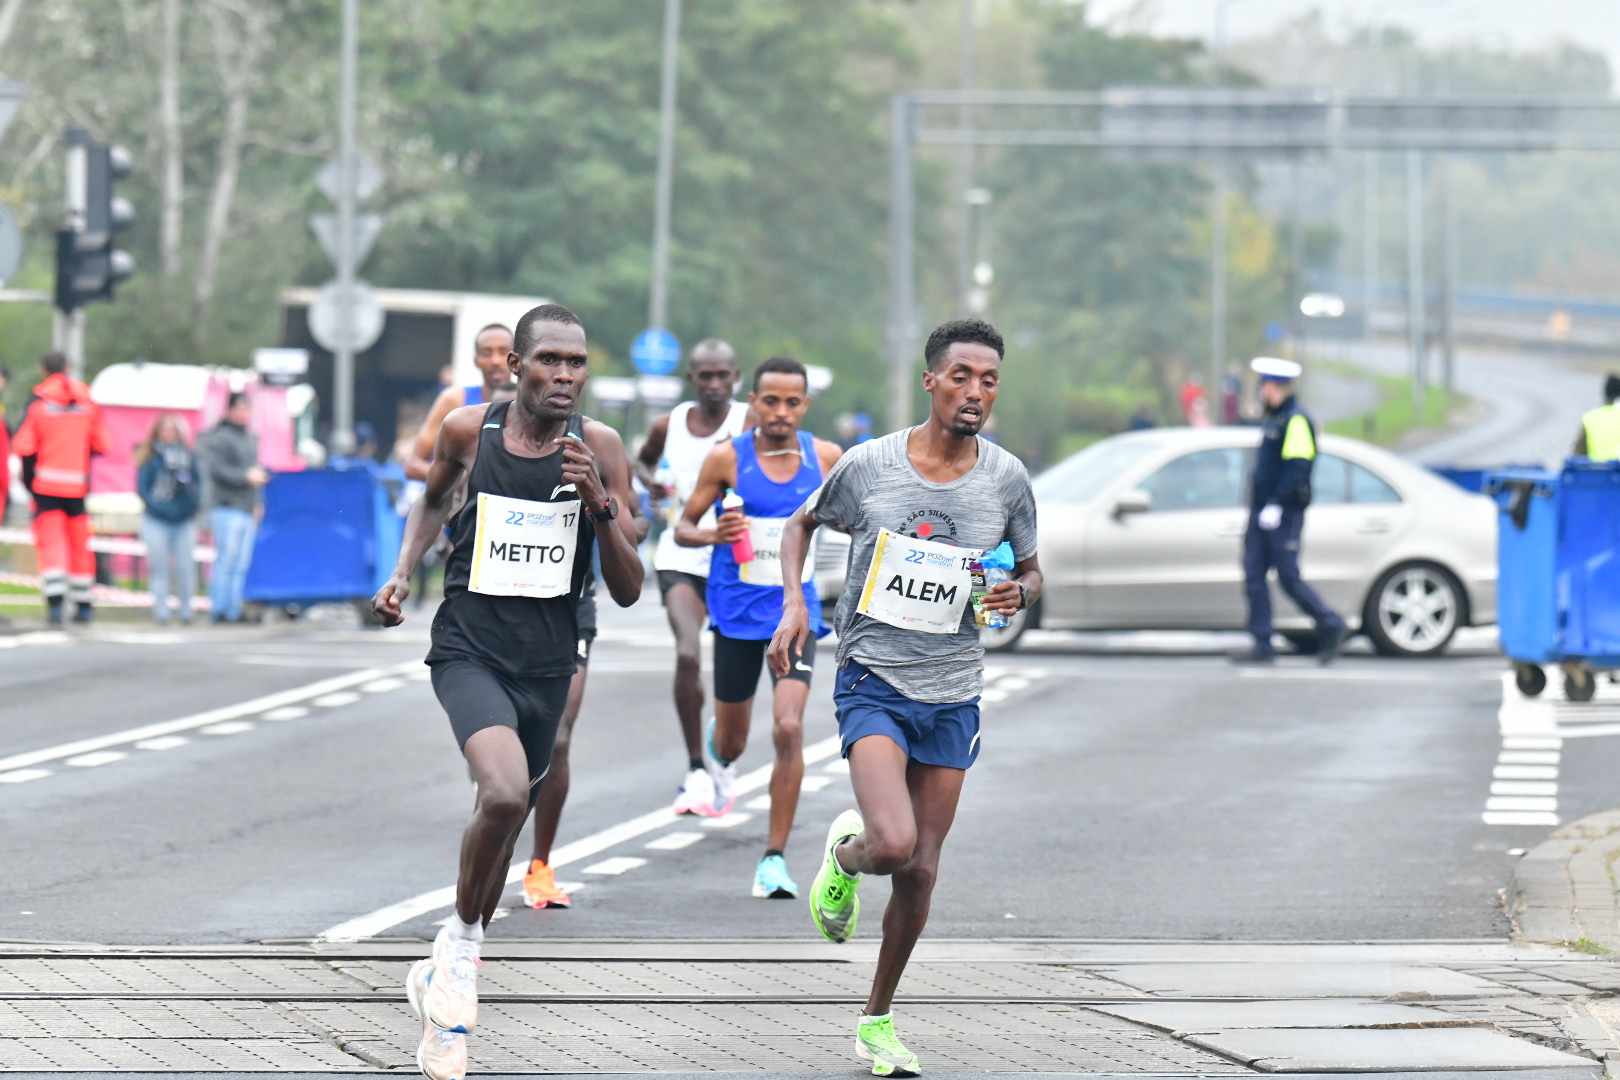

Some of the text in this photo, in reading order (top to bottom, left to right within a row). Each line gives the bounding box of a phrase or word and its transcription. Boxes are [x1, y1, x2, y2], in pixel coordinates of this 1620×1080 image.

[505, 510, 525, 526] 22
[562, 512, 576, 528] 17
[907, 510, 925, 523] SÃO
[928, 509, 957, 536] SILVESTRE
[489, 540, 565, 564] METTO
[904, 549, 925, 564] 22
[925, 558, 953, 568] maraton
[886, 574, 958, 605] ALEM
